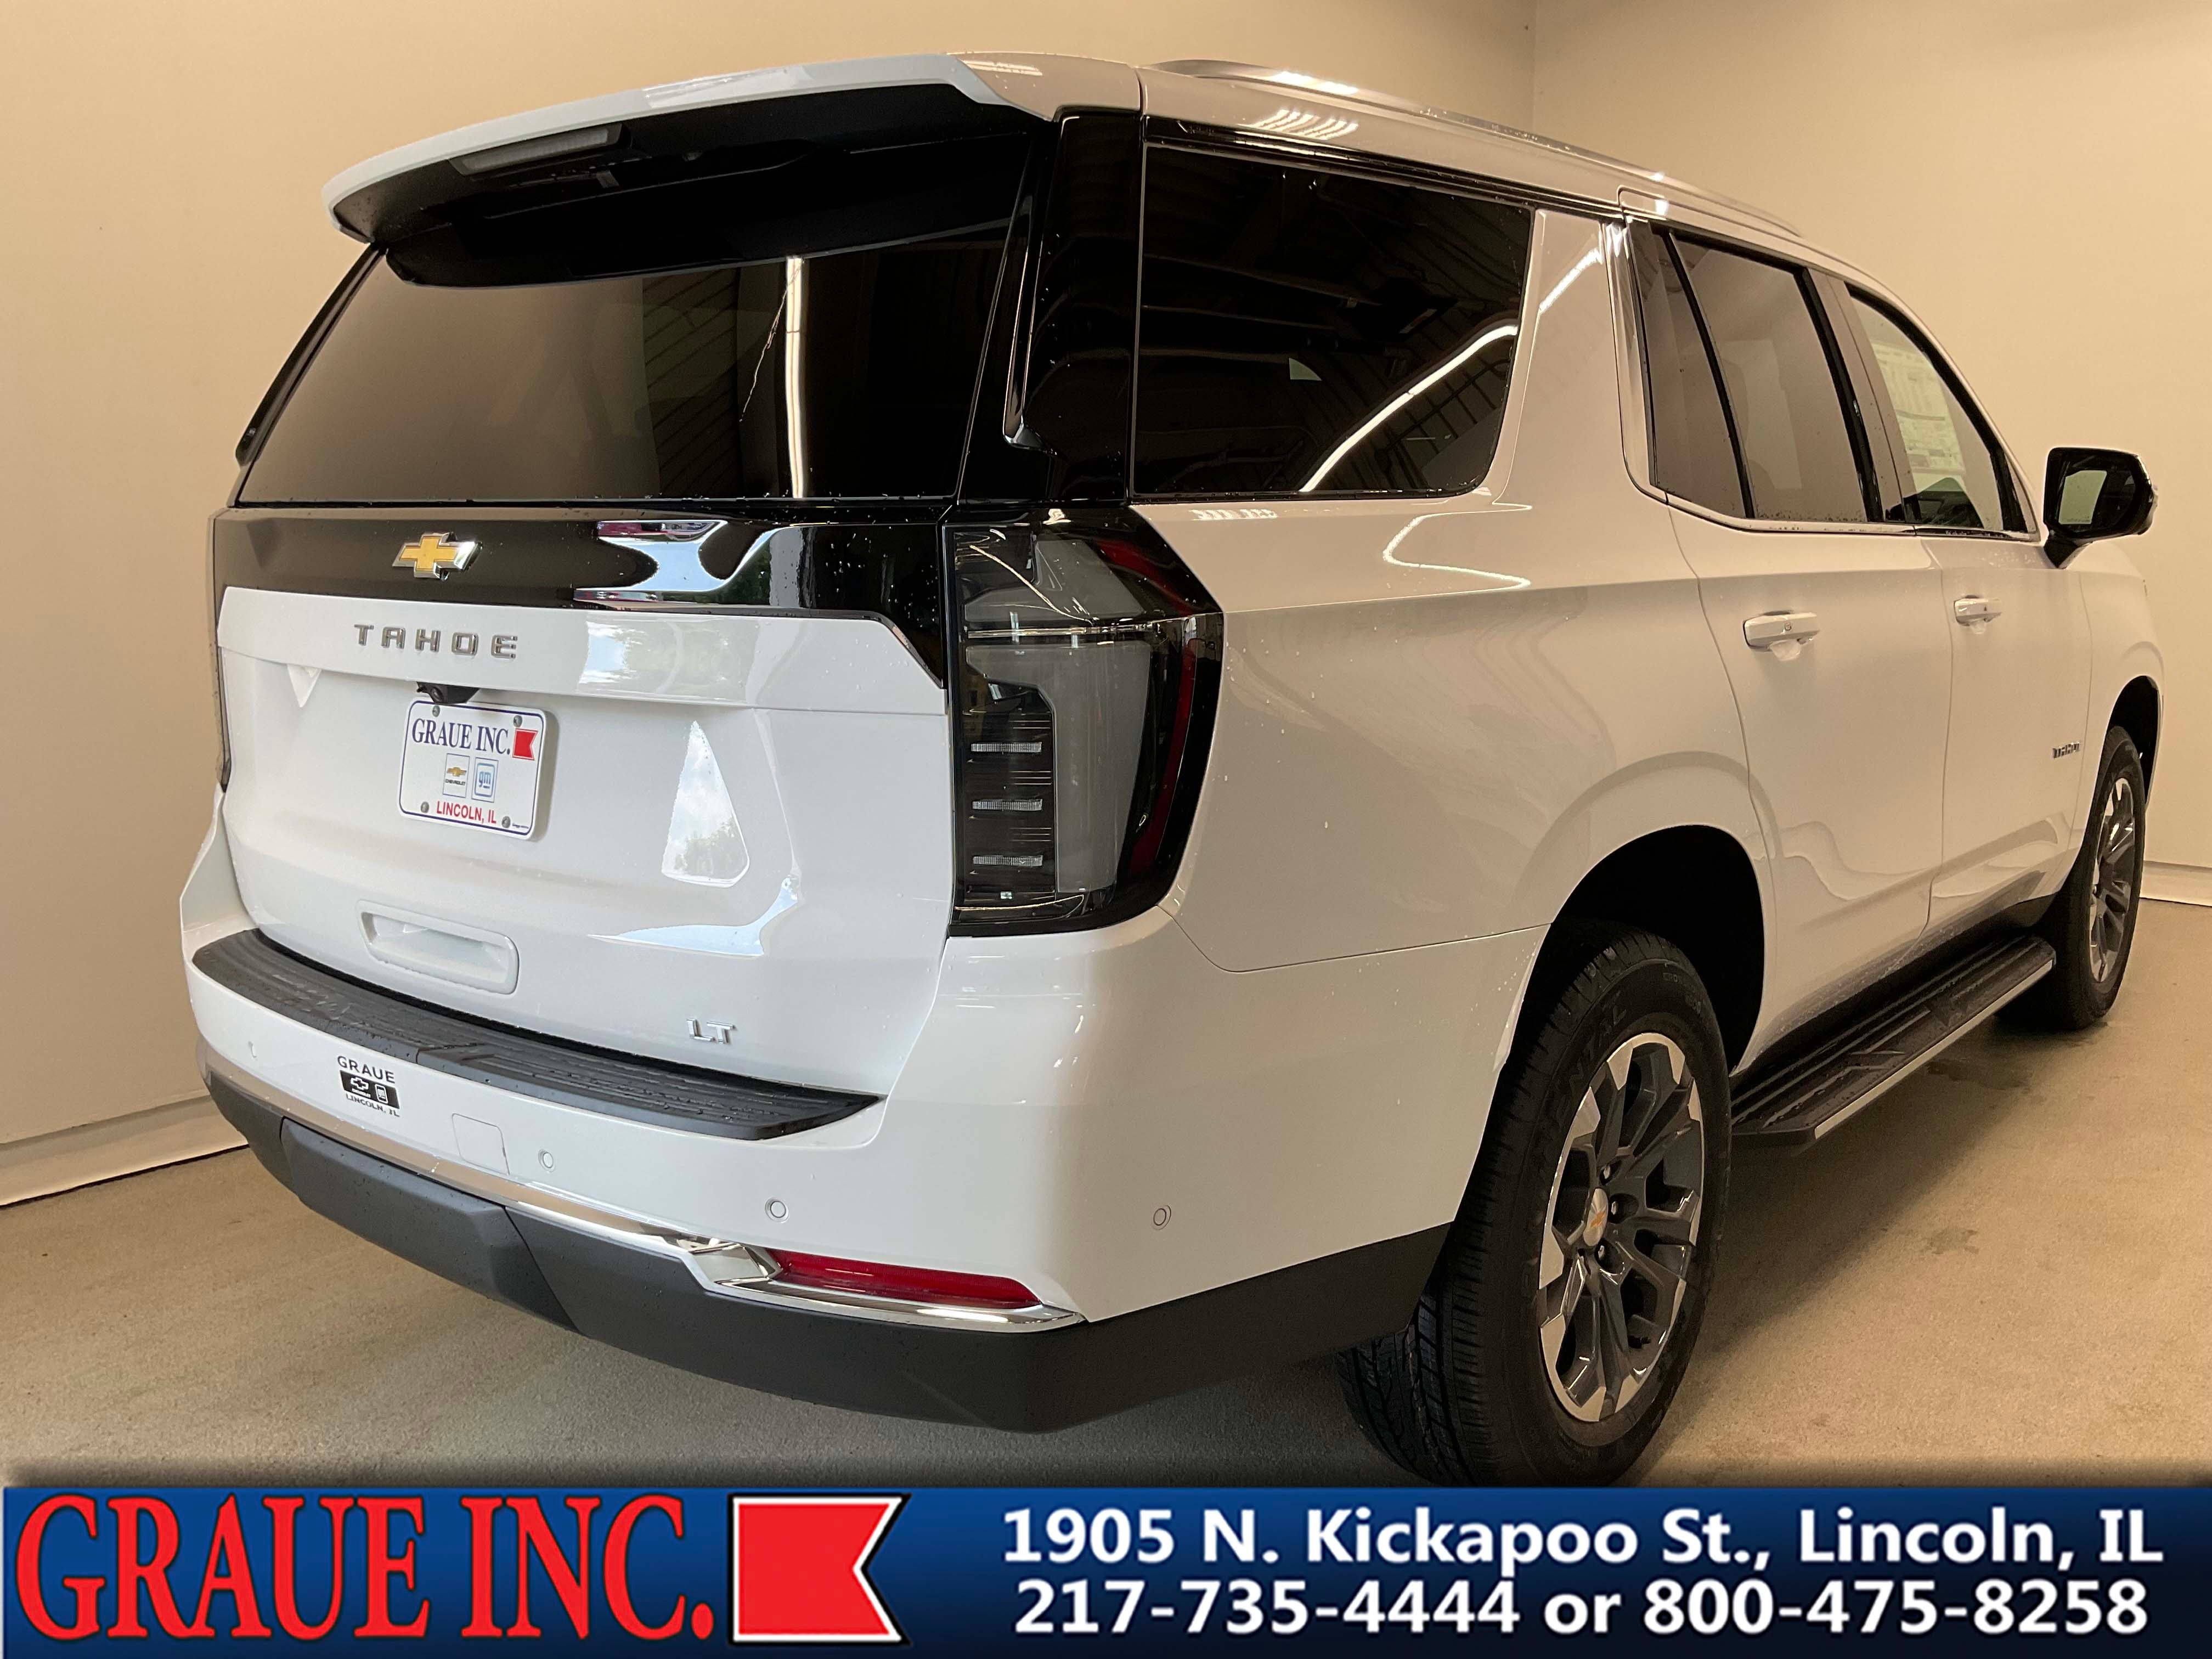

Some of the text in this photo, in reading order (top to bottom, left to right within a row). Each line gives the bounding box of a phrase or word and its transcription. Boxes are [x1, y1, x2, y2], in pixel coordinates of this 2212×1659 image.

[354, 624, 518, 658] TAHOE
[412, 718, 511, 755] GRAUE INC.
[437, 800, 496, 823] LINCOLN, IL
[687, 1018, 737, 1045] LT
[337, 1056, 395, 1084] GRAUE
[346, 1093, 386, 1114] LINCOLN,
